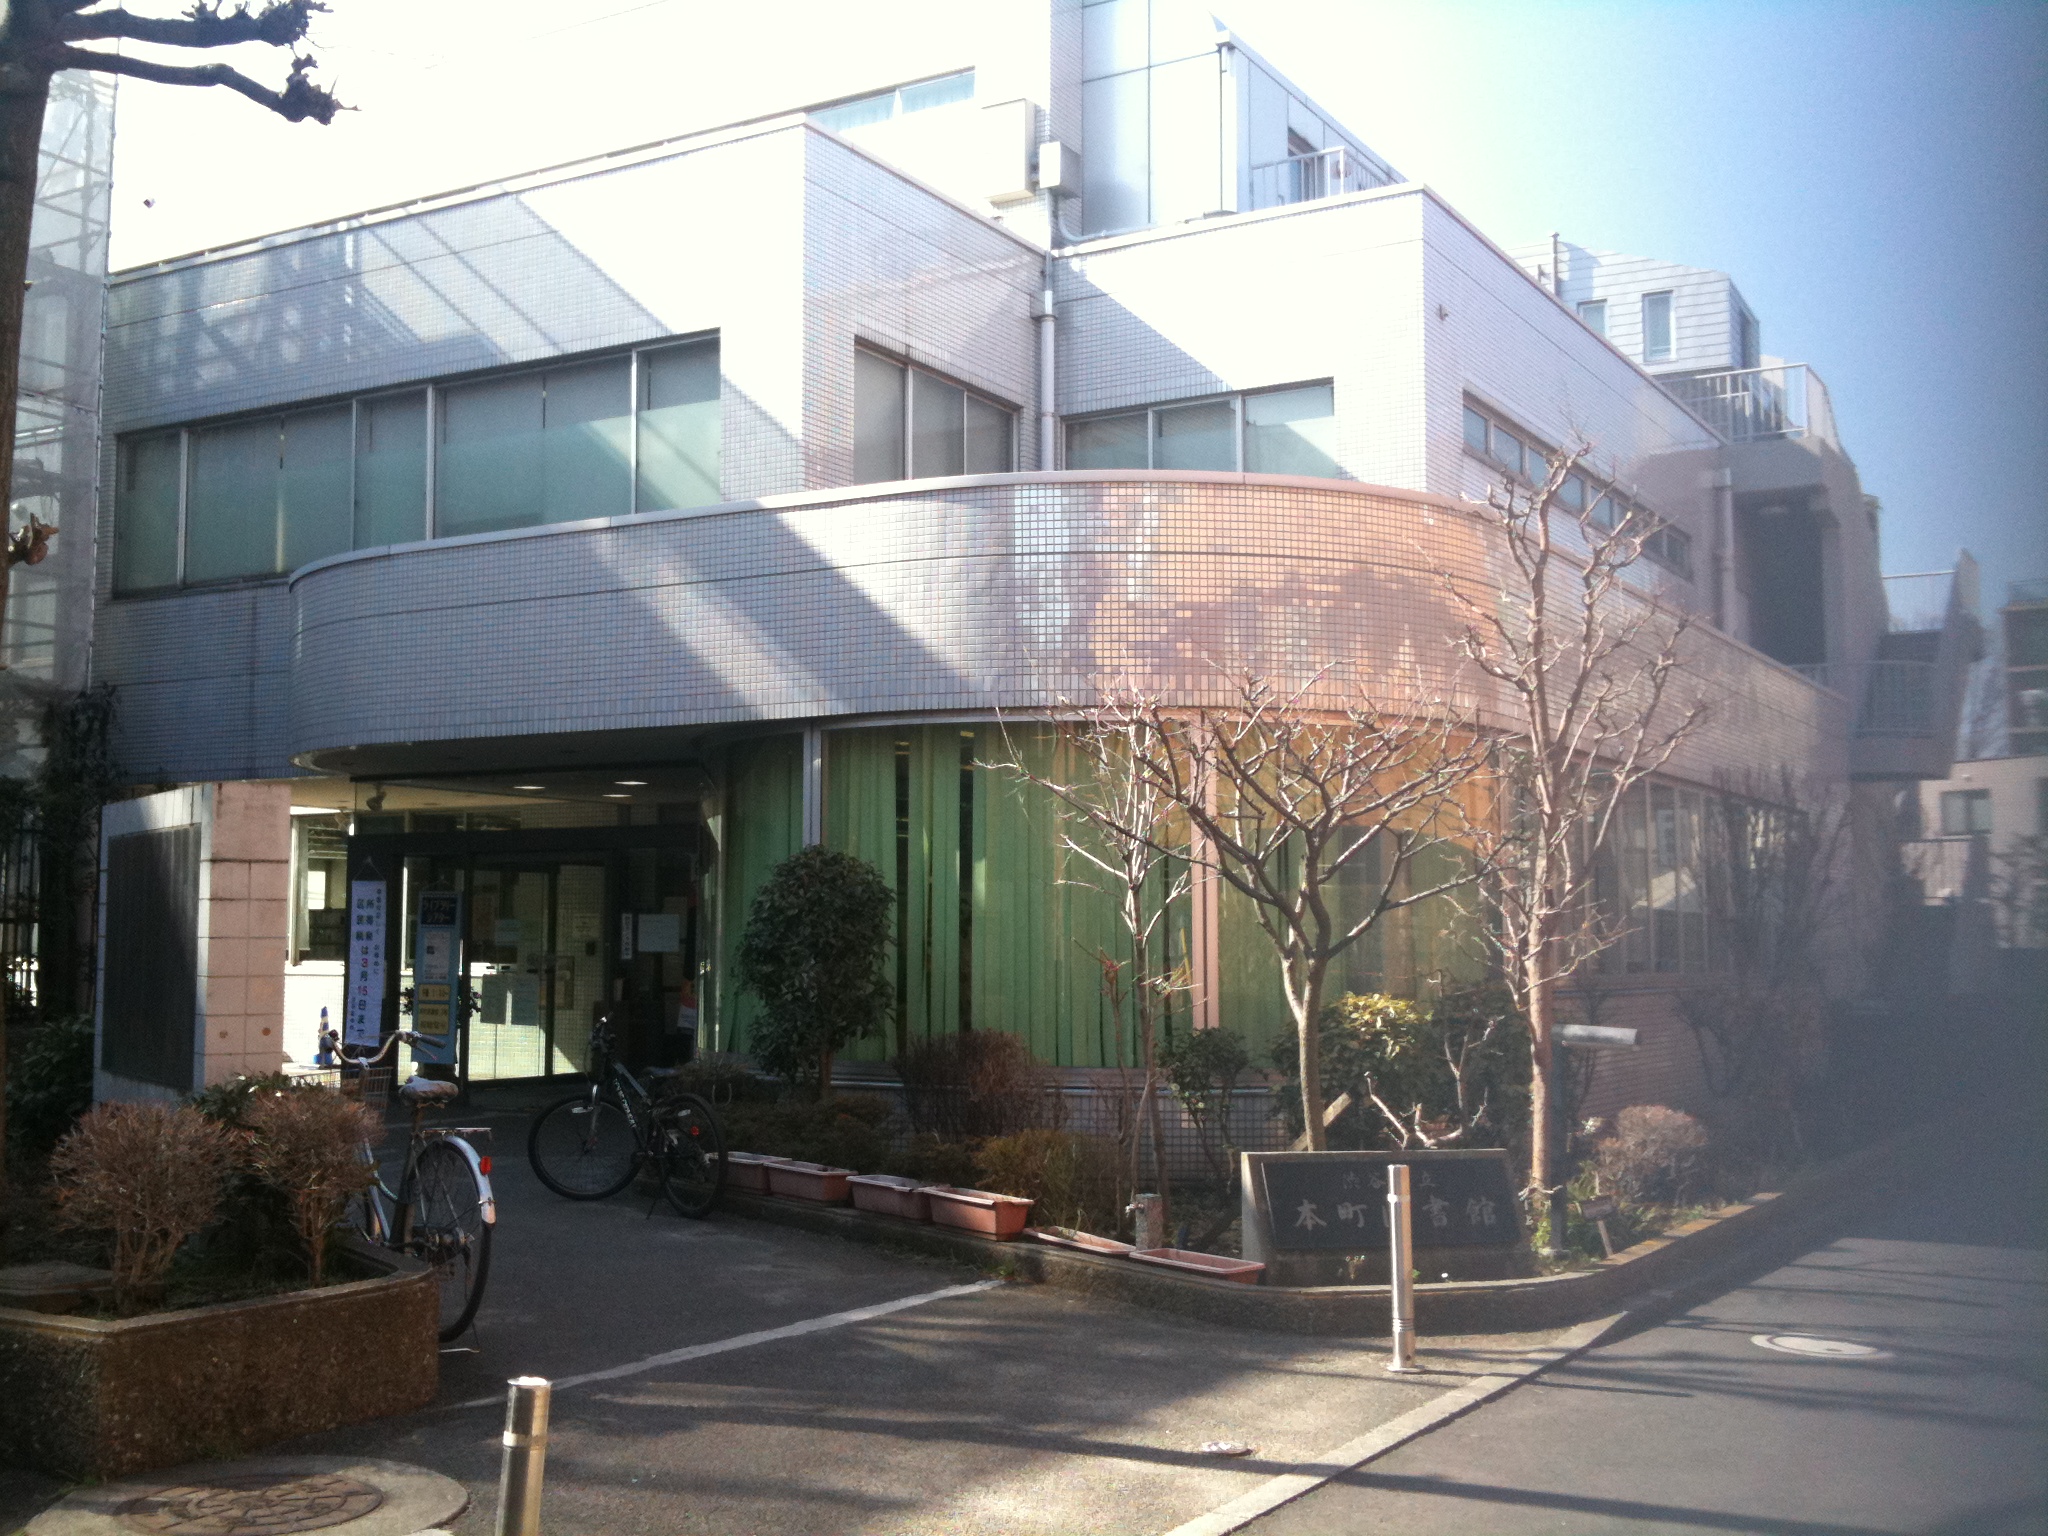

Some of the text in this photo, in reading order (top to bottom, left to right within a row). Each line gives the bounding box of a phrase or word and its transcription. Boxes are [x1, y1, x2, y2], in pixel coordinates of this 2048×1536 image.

[1342, 1171, 1437, 1190] 渋谷立
[1295, 1194, 1498, 1231] 本町書館
